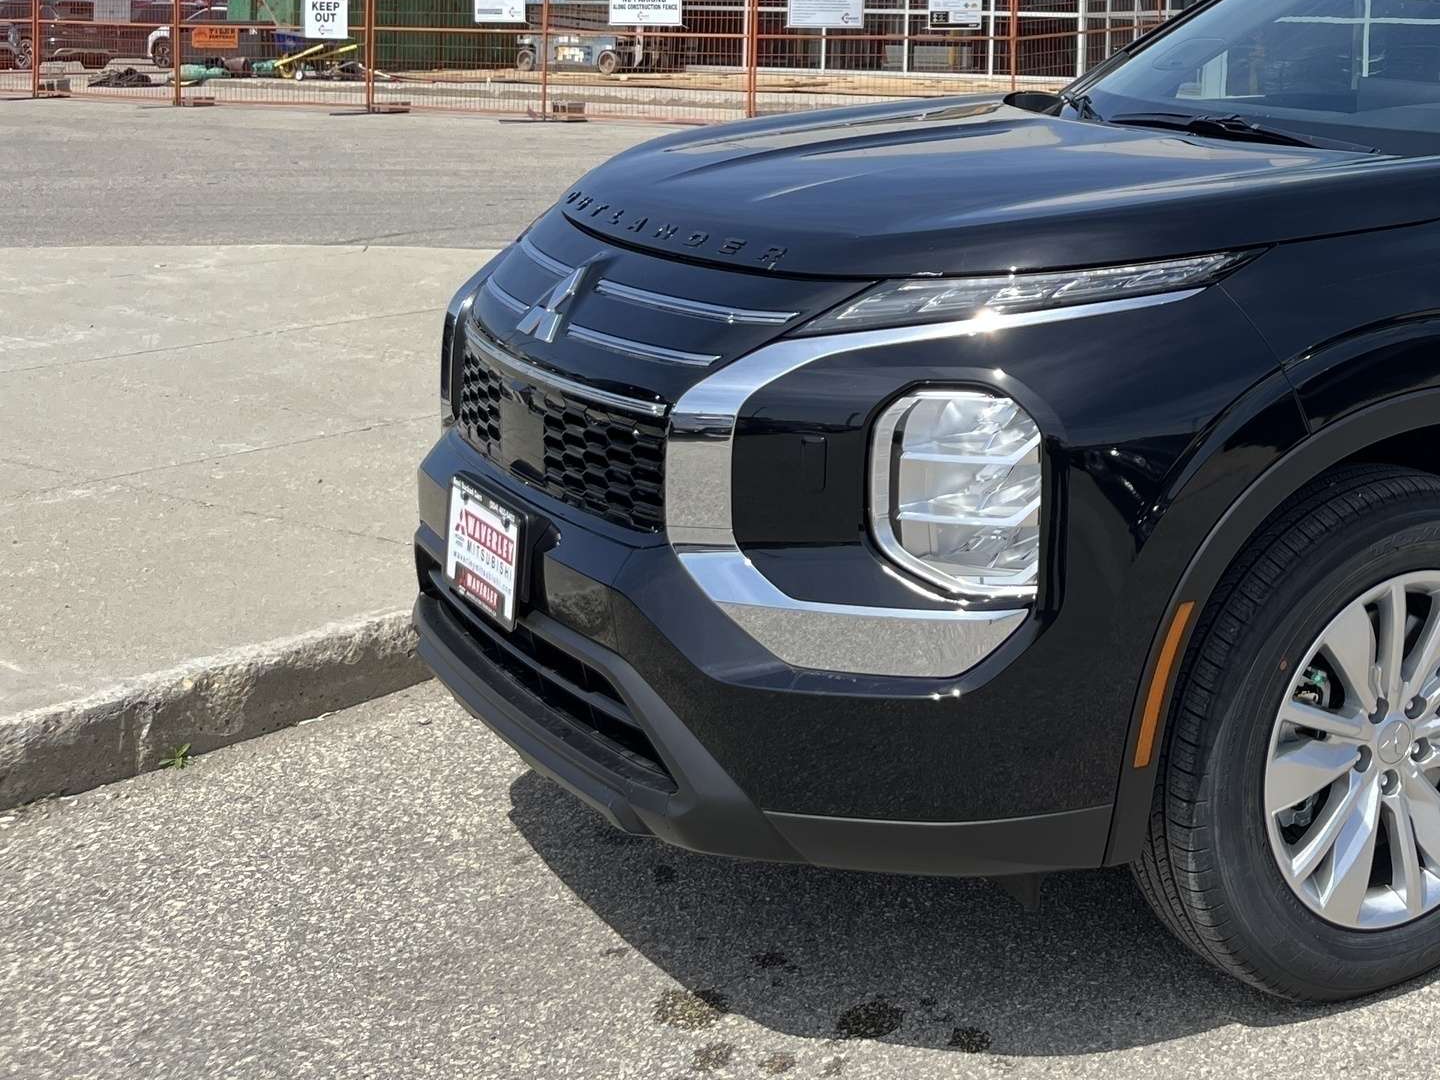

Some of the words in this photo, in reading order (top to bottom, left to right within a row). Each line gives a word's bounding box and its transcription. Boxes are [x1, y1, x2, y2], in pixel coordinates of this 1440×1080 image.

[312, 1, 340, 12] KEEP
[315, 13, 337, 23] OUT
[567, 191, 788, 265] OUTLANDER
[467, 512, 514, 562] WAVERLEY
[467, 539, 512, 579] MITSUBISHI
